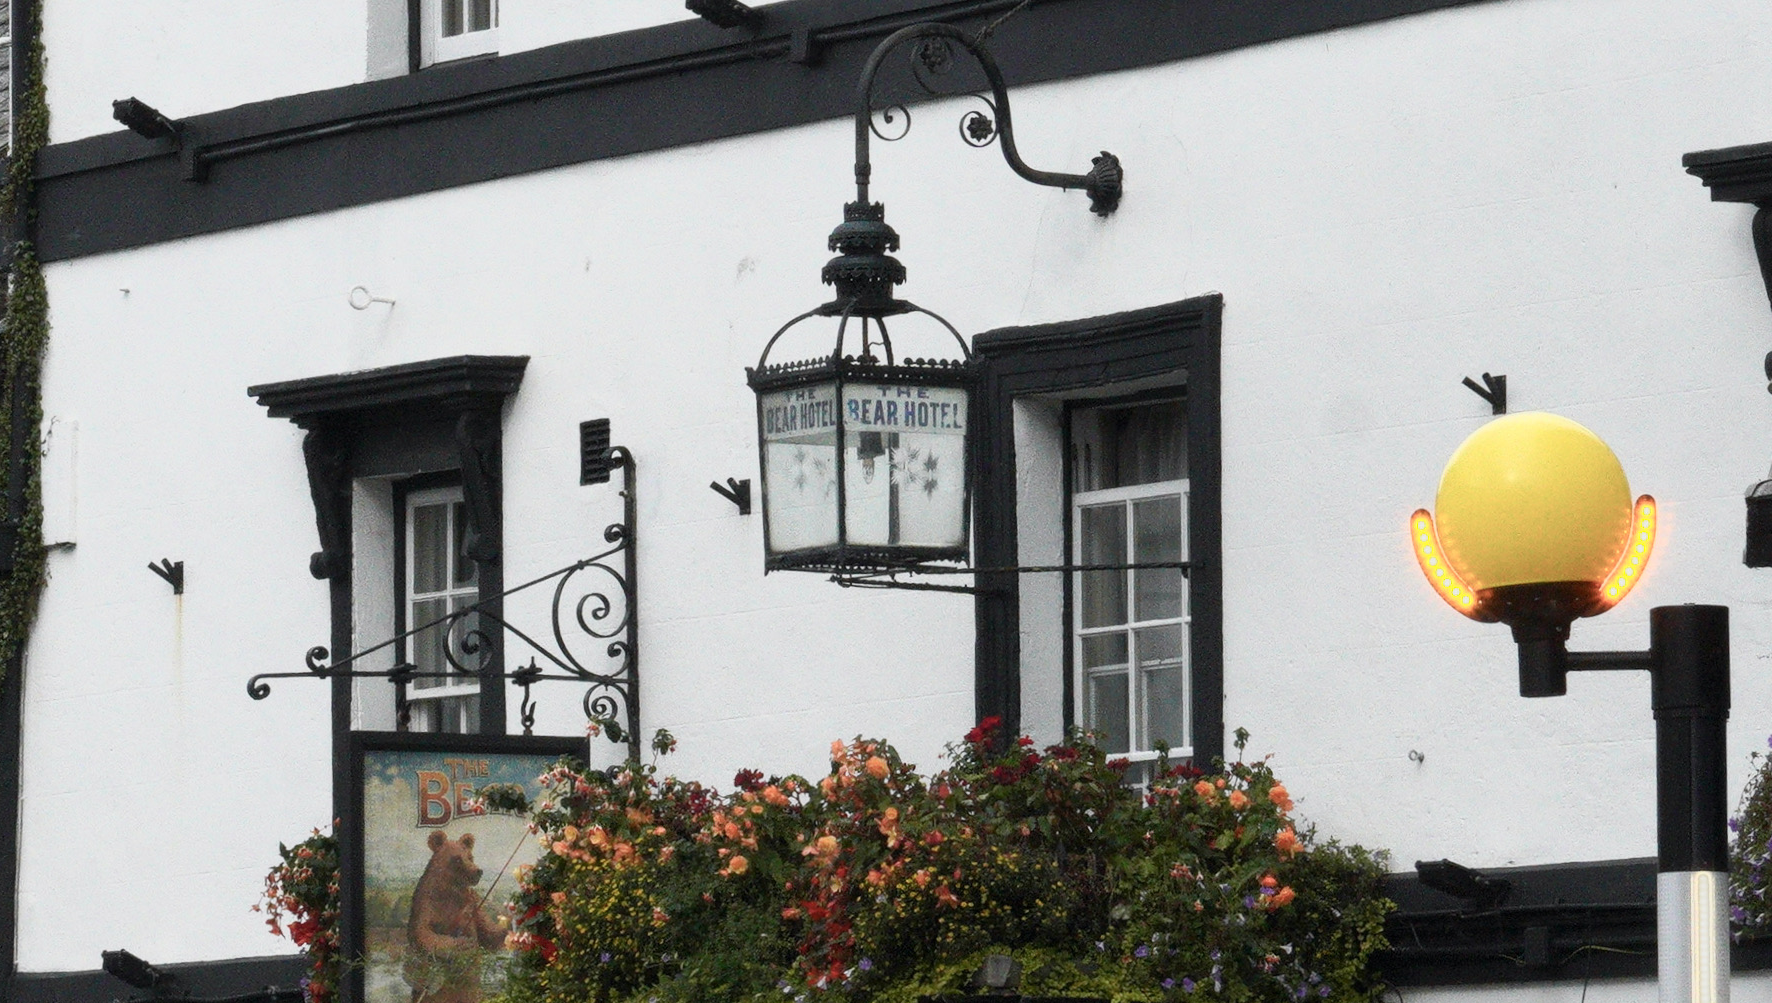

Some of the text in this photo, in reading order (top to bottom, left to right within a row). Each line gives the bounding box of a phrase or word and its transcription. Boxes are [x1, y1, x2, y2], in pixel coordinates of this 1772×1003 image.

[801, 400, 836, 430] HOTEL
[848, 398, 963, 429] BEAR HOTEL
[444, 757, 490, 780] THE
